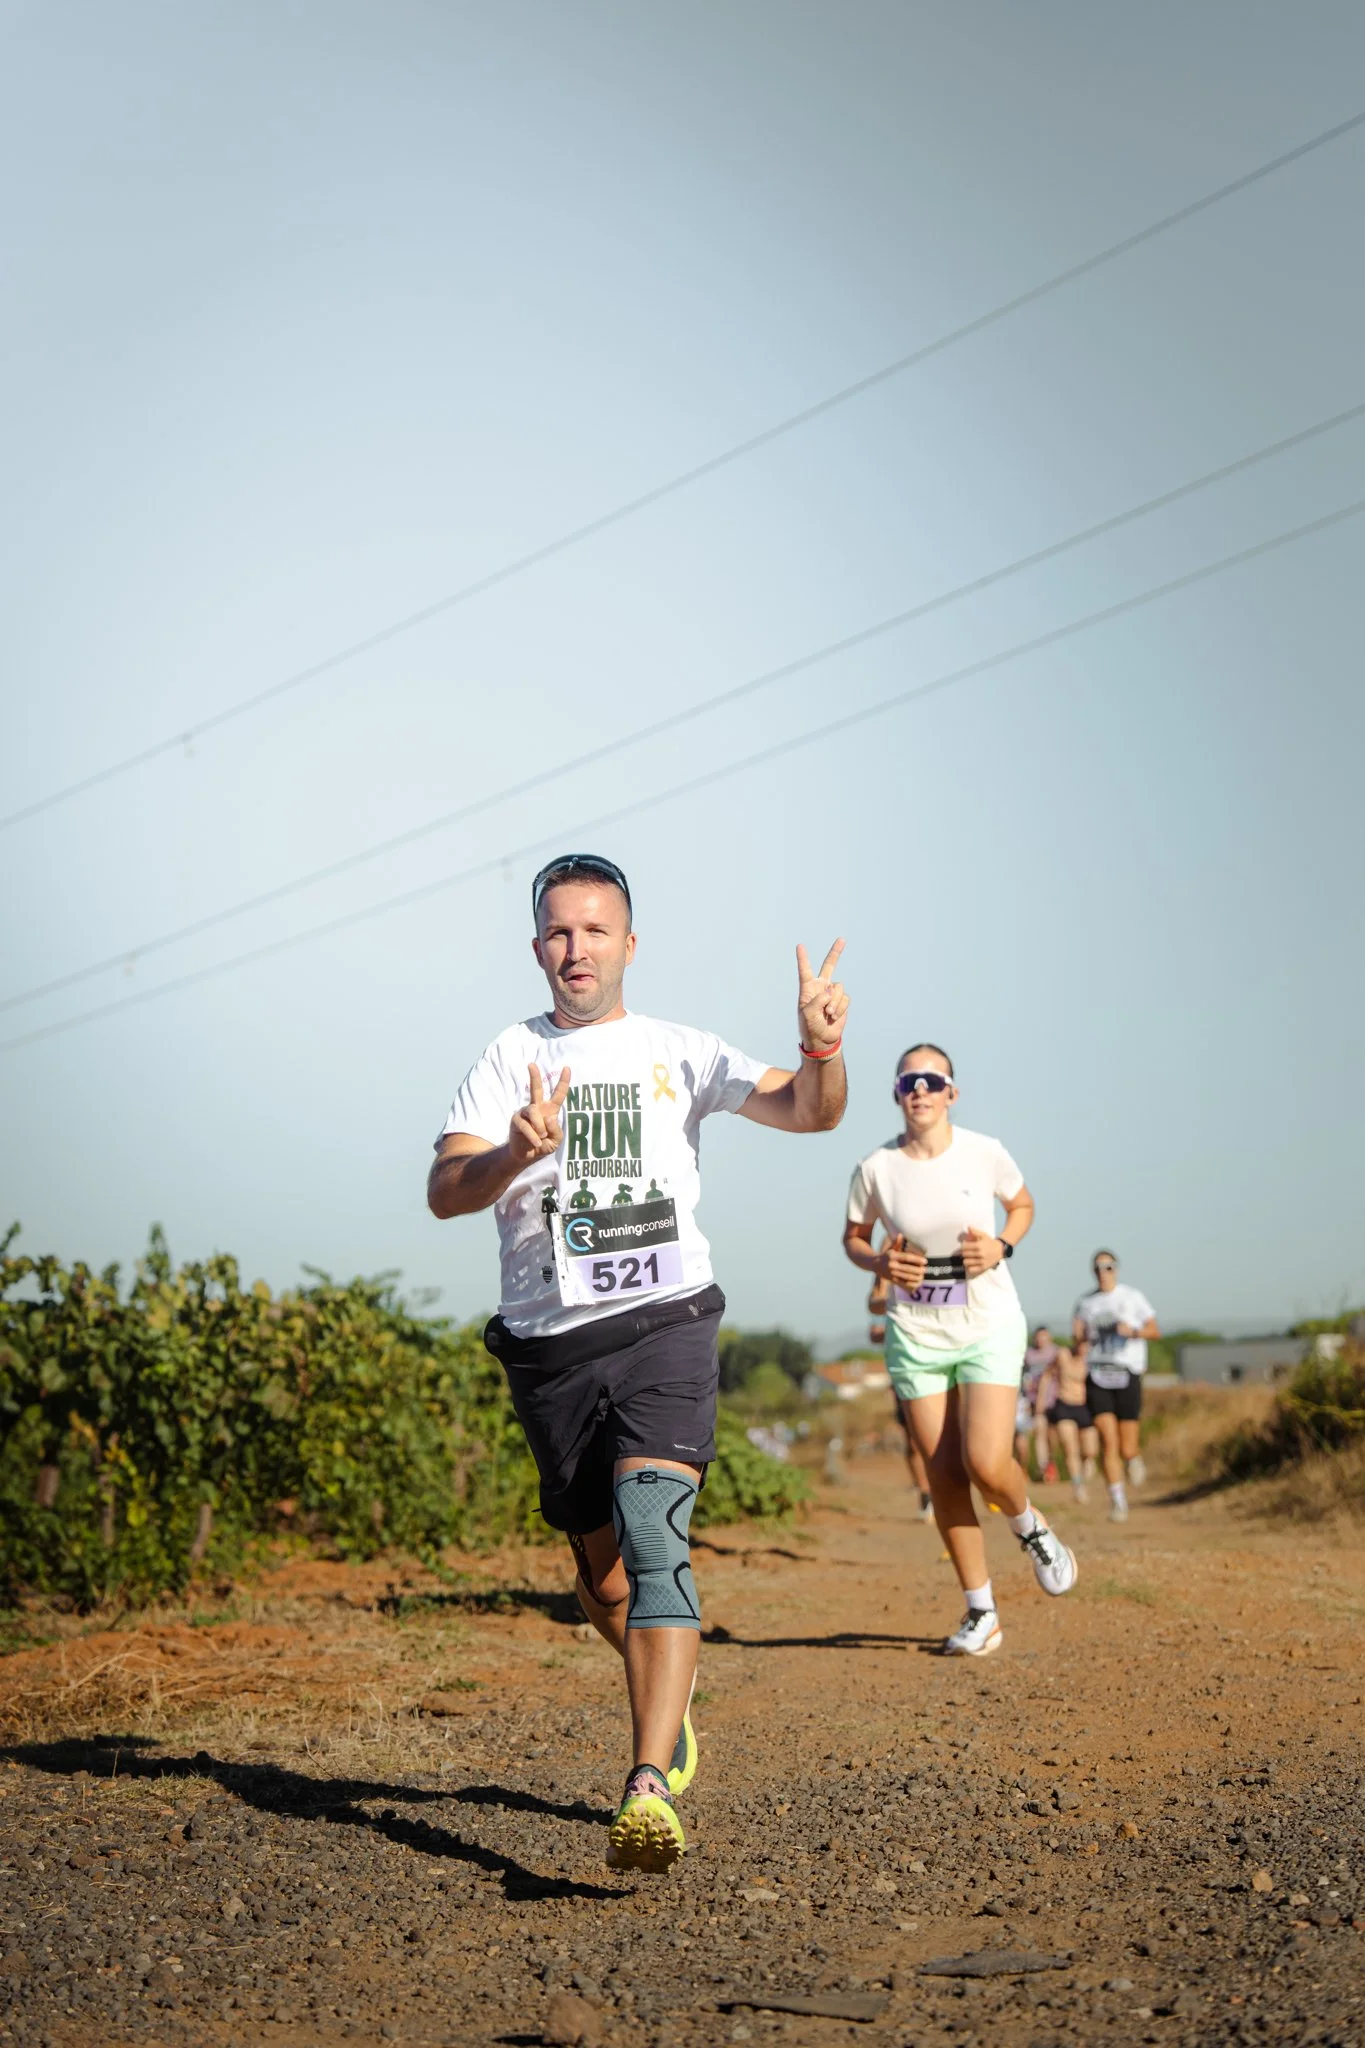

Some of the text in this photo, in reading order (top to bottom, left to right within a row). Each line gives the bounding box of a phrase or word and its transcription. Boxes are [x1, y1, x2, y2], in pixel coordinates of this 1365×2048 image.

[567, 1083, 641, 1111] NATURE
[567, 1111, 641, 1160] RUN
[567, 1159, 642, 1180] DE BOURBAKI
[598, 1216, 675, 1239] runningconseil
[592, 1252, 659, 1293] 521
